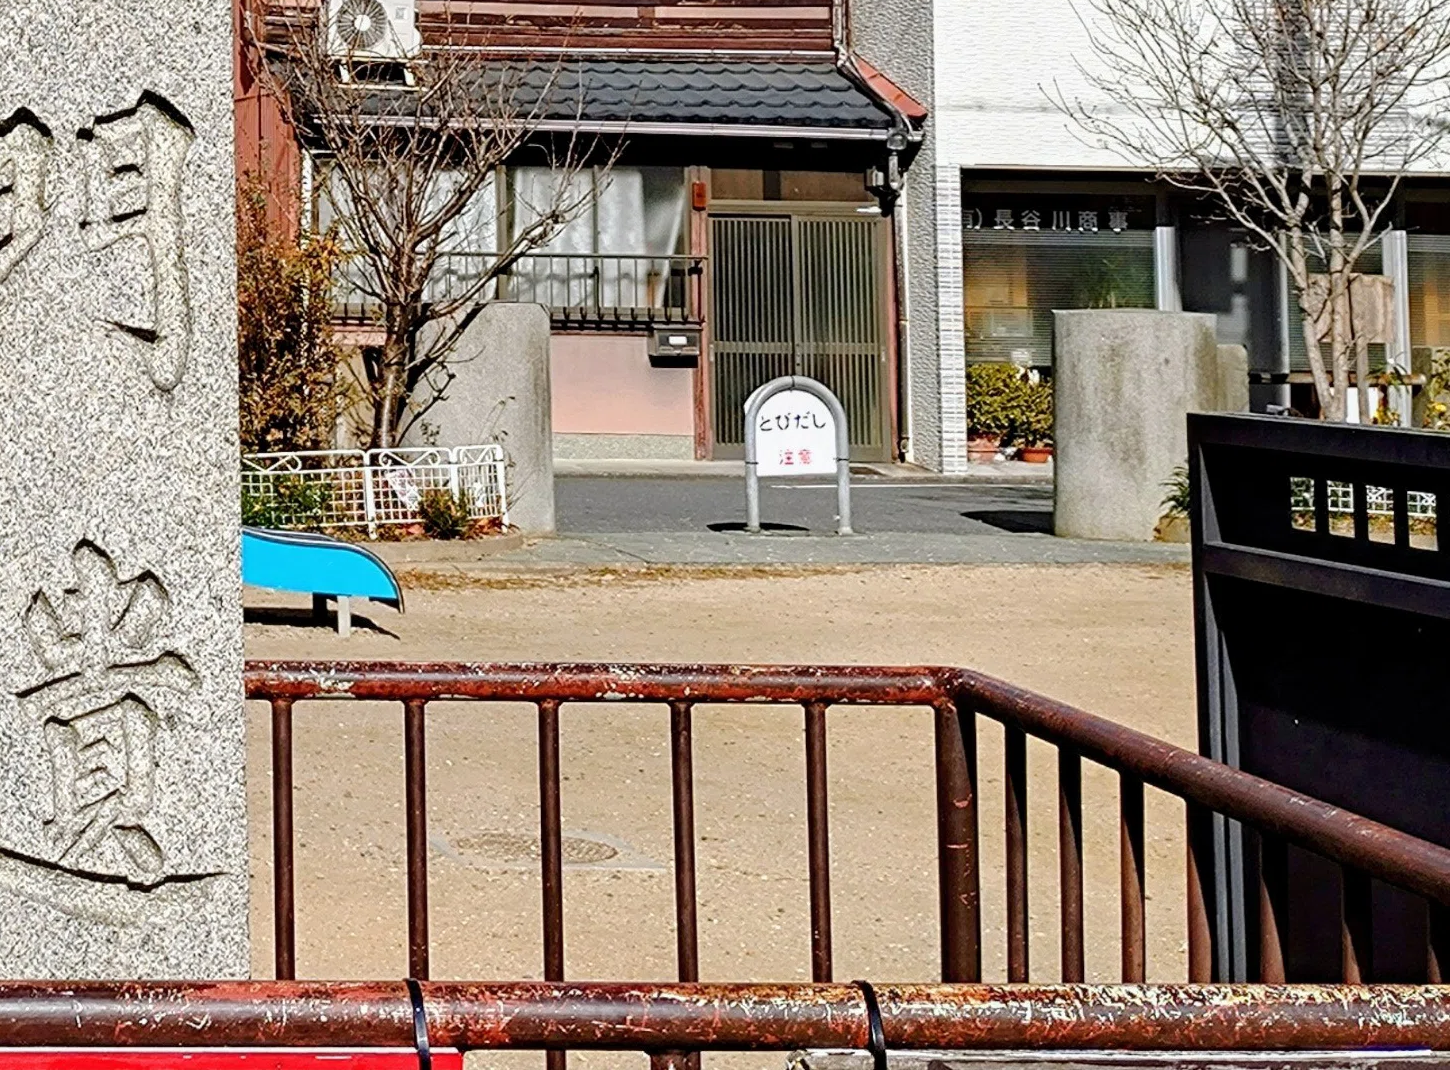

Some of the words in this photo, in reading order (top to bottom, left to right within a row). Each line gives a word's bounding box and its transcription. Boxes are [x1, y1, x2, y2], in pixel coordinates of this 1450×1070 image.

[759, 411, 826, 431] とびだし
[779, 449, 812, 465] 注意
